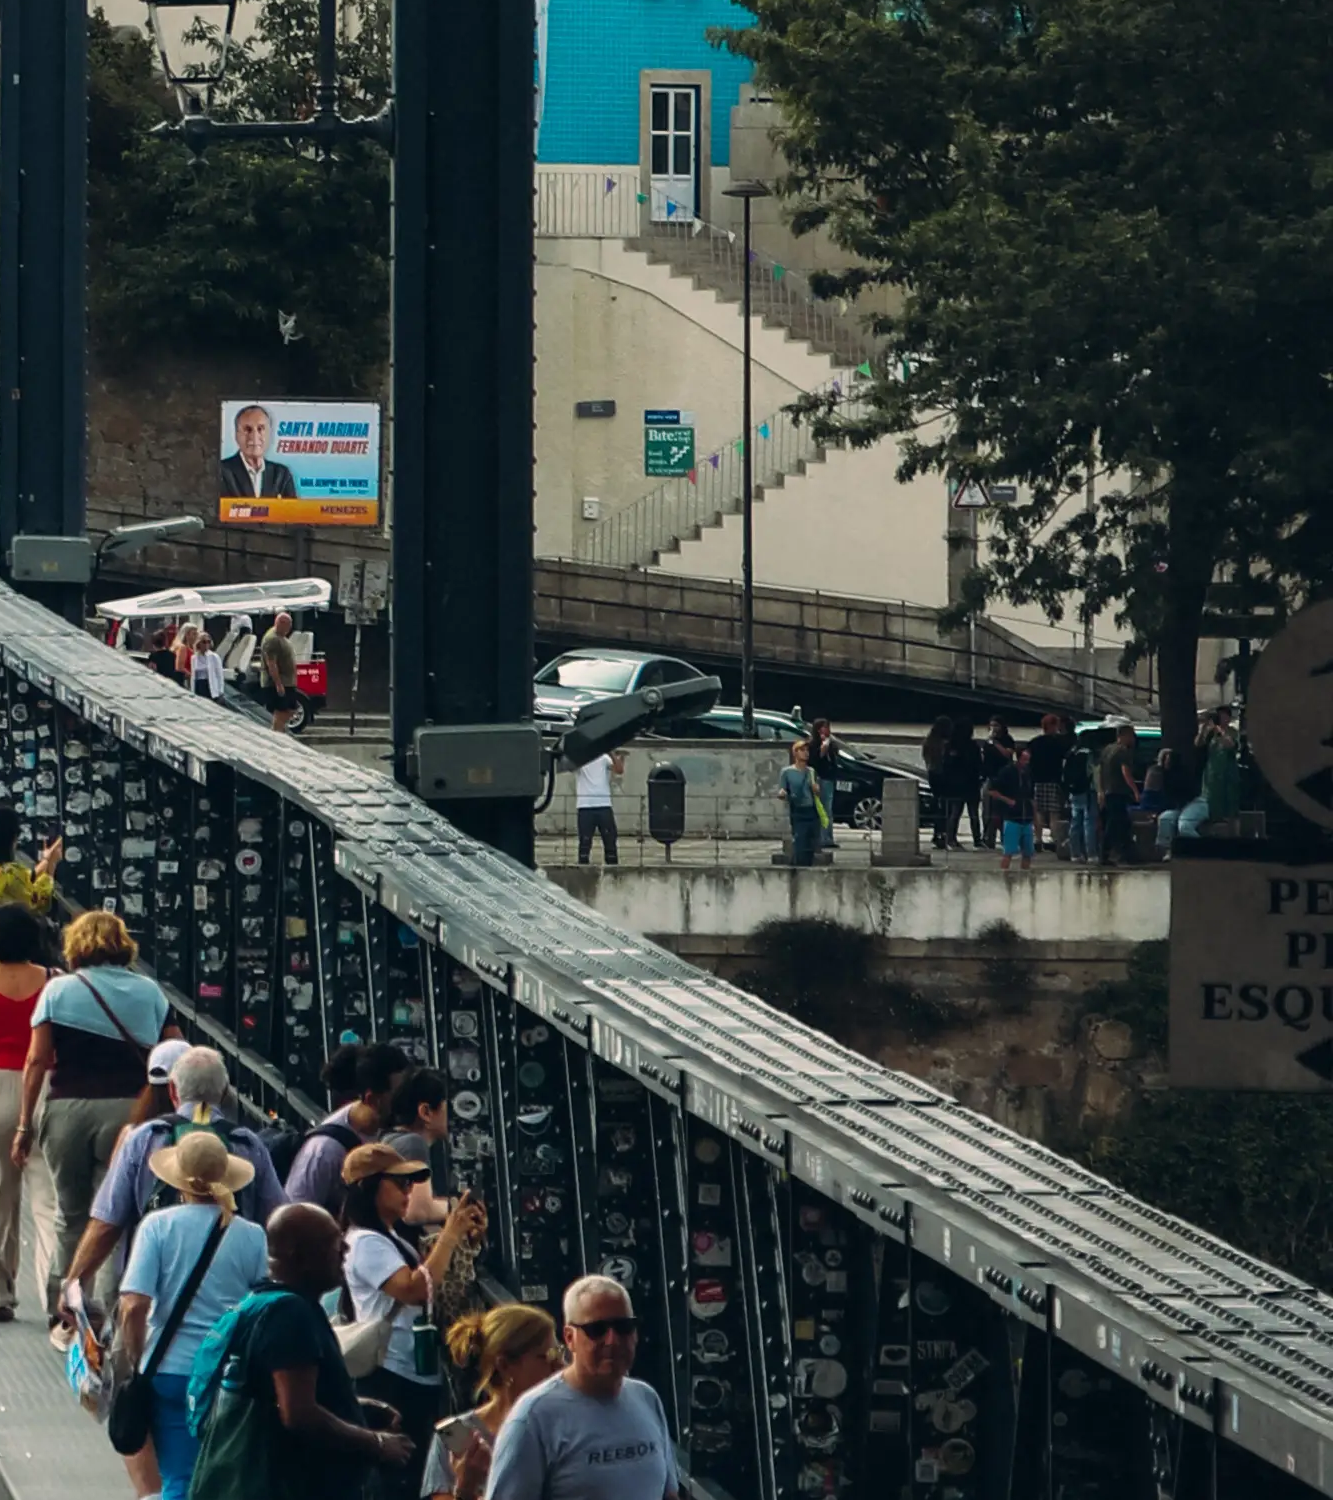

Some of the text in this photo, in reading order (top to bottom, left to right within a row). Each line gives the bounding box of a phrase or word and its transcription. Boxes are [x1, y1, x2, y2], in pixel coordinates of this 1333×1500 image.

[277, 421, 370, 438] SANTA MARINHA
[277, 440, 369, 455] FERNANDO DUARTE
[320, 505, 368, 515] MENEZES
[1267, 878, 1333, 915] PE
[1286, 931, 1333, 969] P
[588, 1441, 658, 1467] REEBOK
